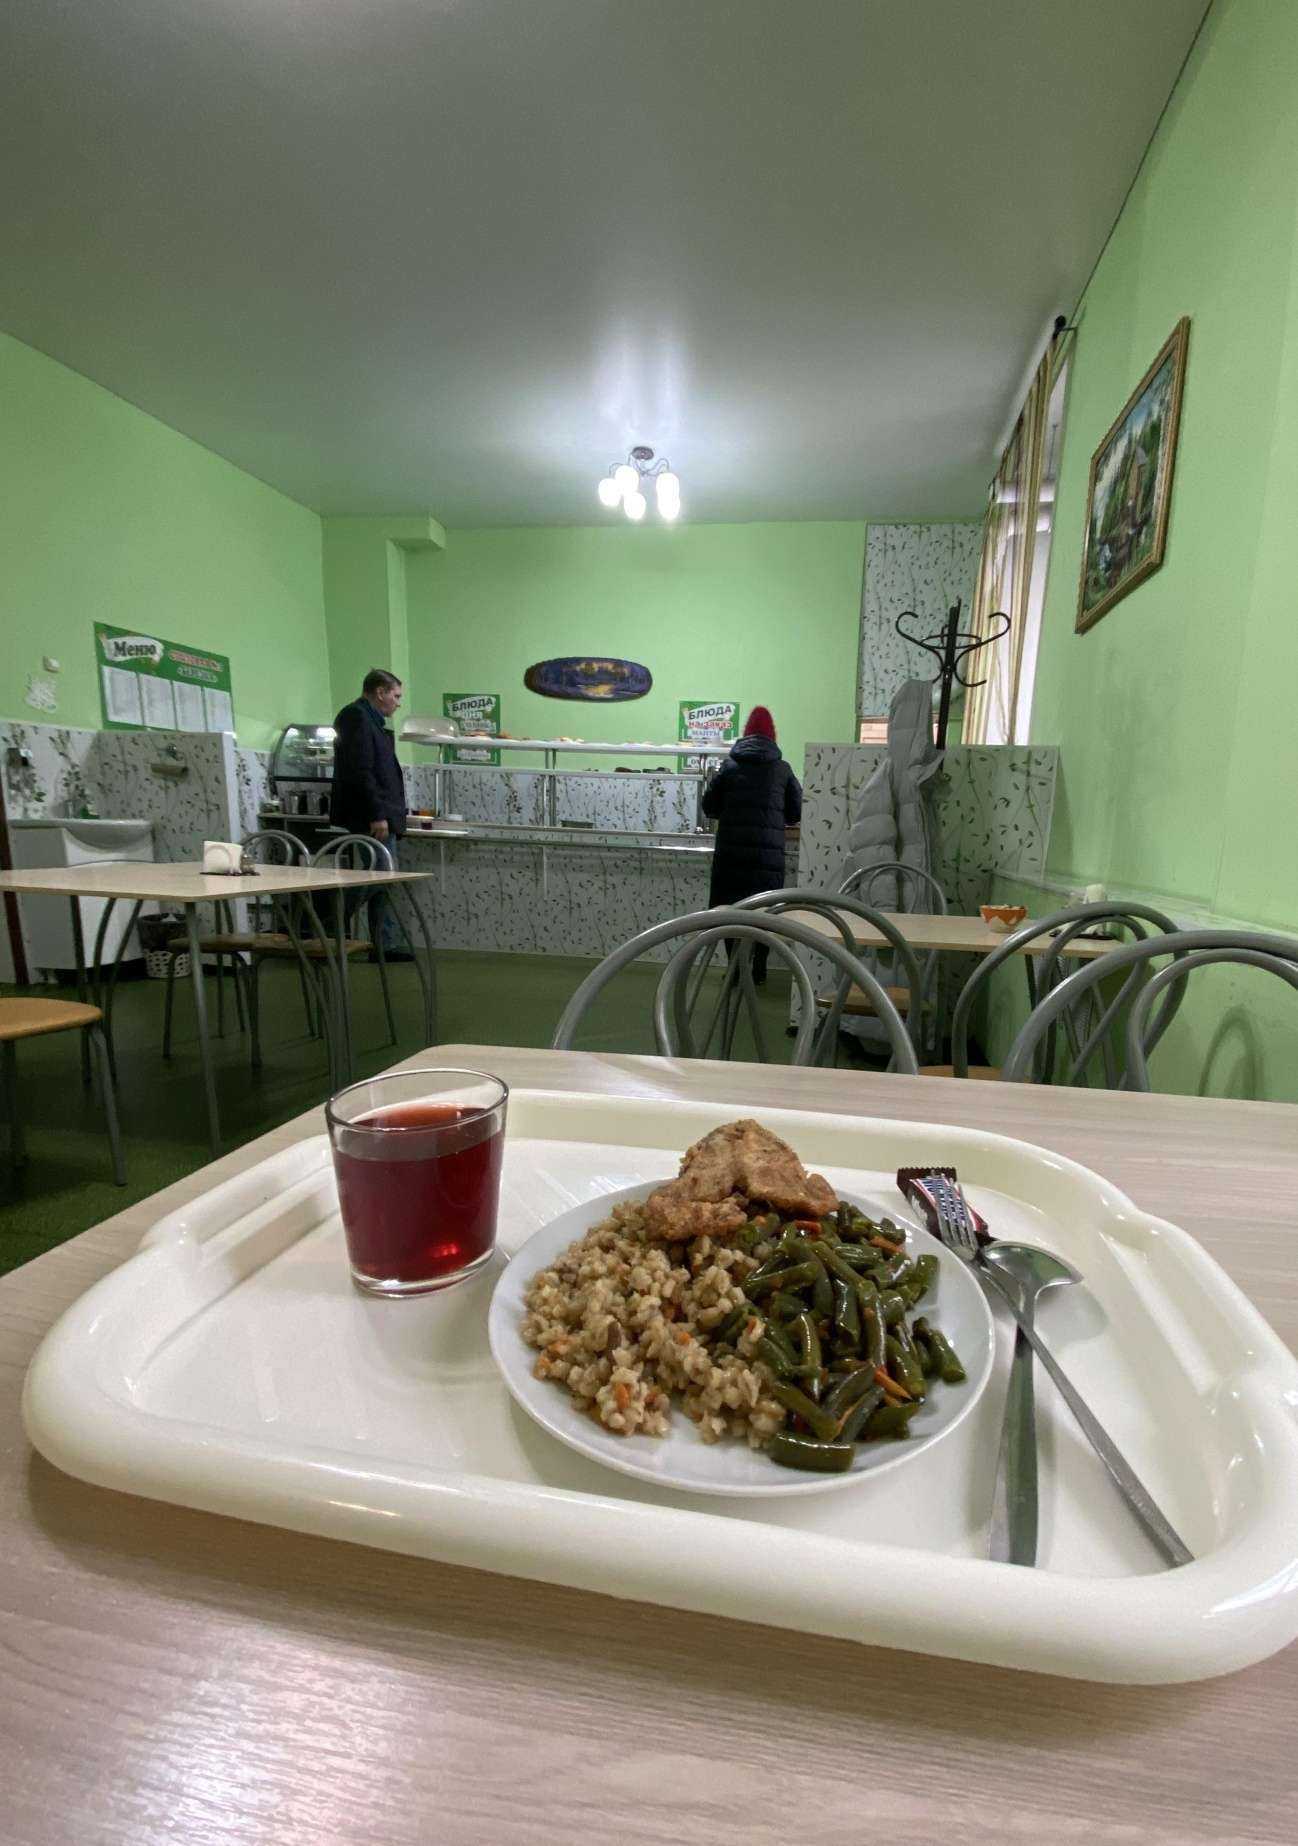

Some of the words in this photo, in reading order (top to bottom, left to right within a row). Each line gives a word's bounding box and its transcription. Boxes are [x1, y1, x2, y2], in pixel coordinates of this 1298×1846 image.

[113, 641, 157, 657] Меню
[452, 697, 493, 712] БЛЮДА
[688, 705, 732, 720] БЛЮДА
